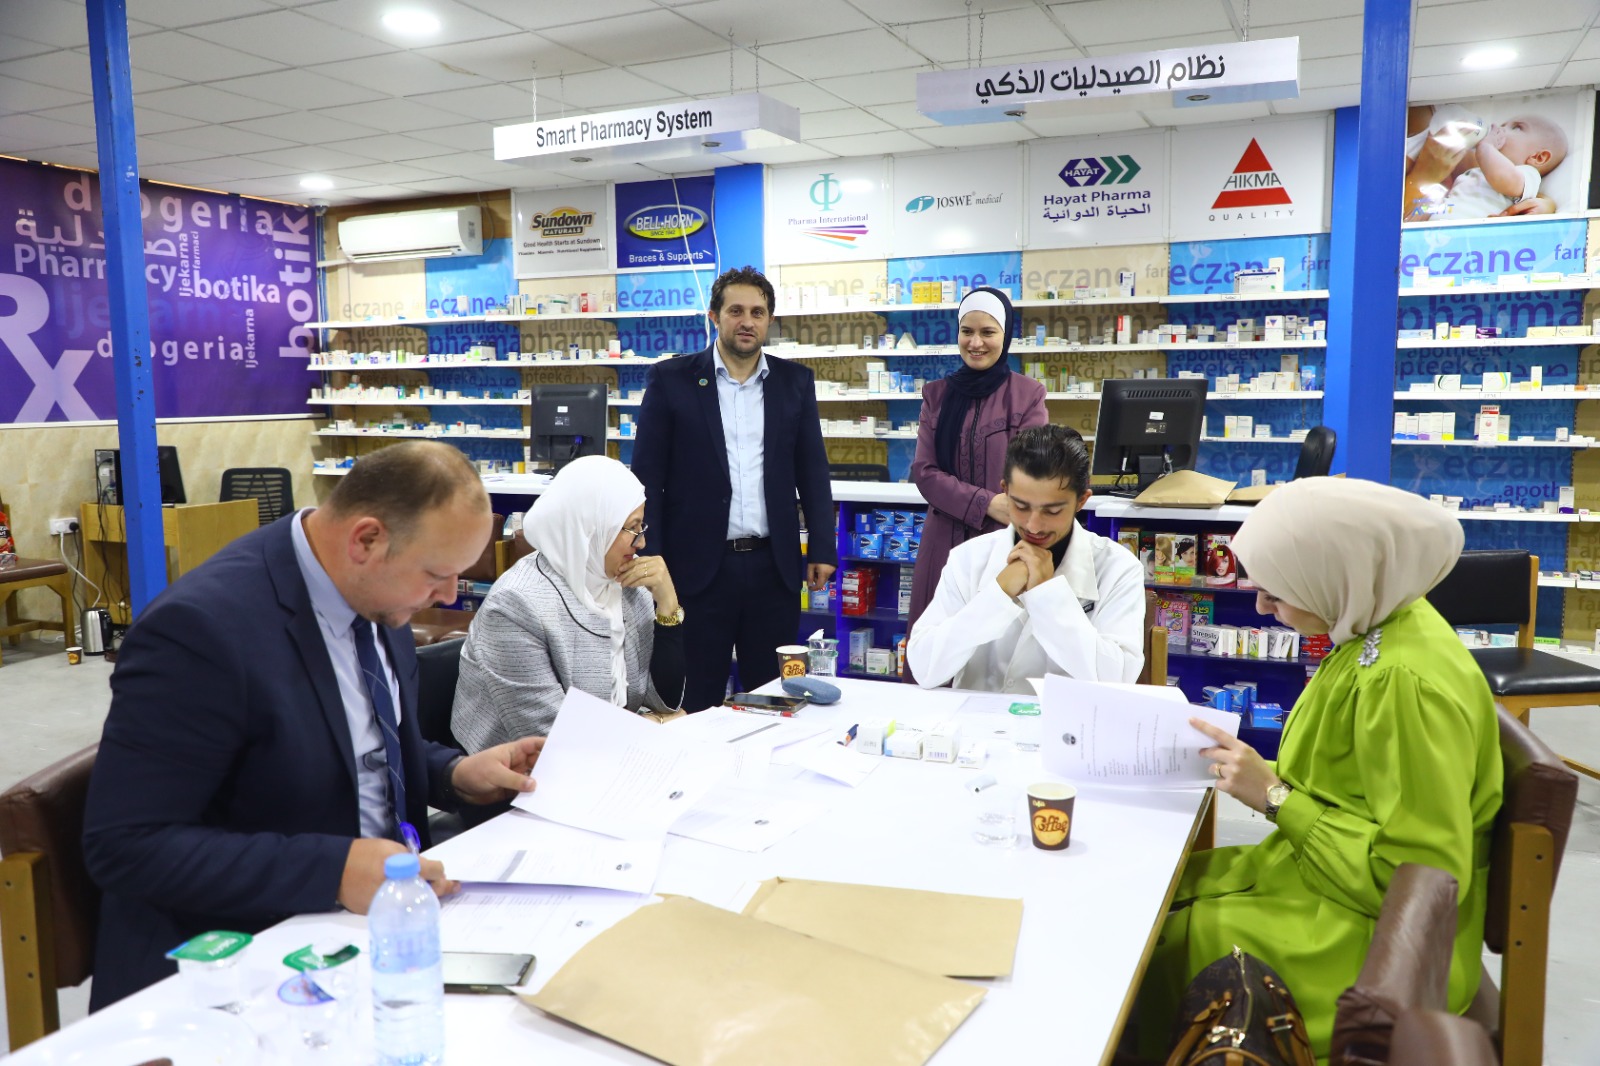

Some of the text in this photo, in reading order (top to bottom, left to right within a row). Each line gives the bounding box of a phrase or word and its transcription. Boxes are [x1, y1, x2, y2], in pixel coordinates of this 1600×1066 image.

[976, 55, 1226, 103] نظام الصيدليات الذكي
[536, 108, 713, 148] Smart Pharmacy System
[1064, 168, 1100, 177] HAYAT
[1222, 172, 1282, 190] HIKMA
[936, 193, 1003, 210] JOSWE medical
[1044, 190, 1151, 206] Hayat Pharma
[1107, 203, 1151, 217] الحياة
[532, 212, 593, 229] Sundown
[788, 213, 869, 226] Pharma International
[544, 227, 582, 236] NATURALS
[554, 239, 570, 247] Starts
[629, 251, 704, 263] Braces & Supports
[1401, 247, 1537, 278] eczane
[14, 243, 177, 293] Pharcy
[193, 268, 281, 304] botika
[274, 206, 315, 358] botik
[618, 287, 696, 309] eczane
